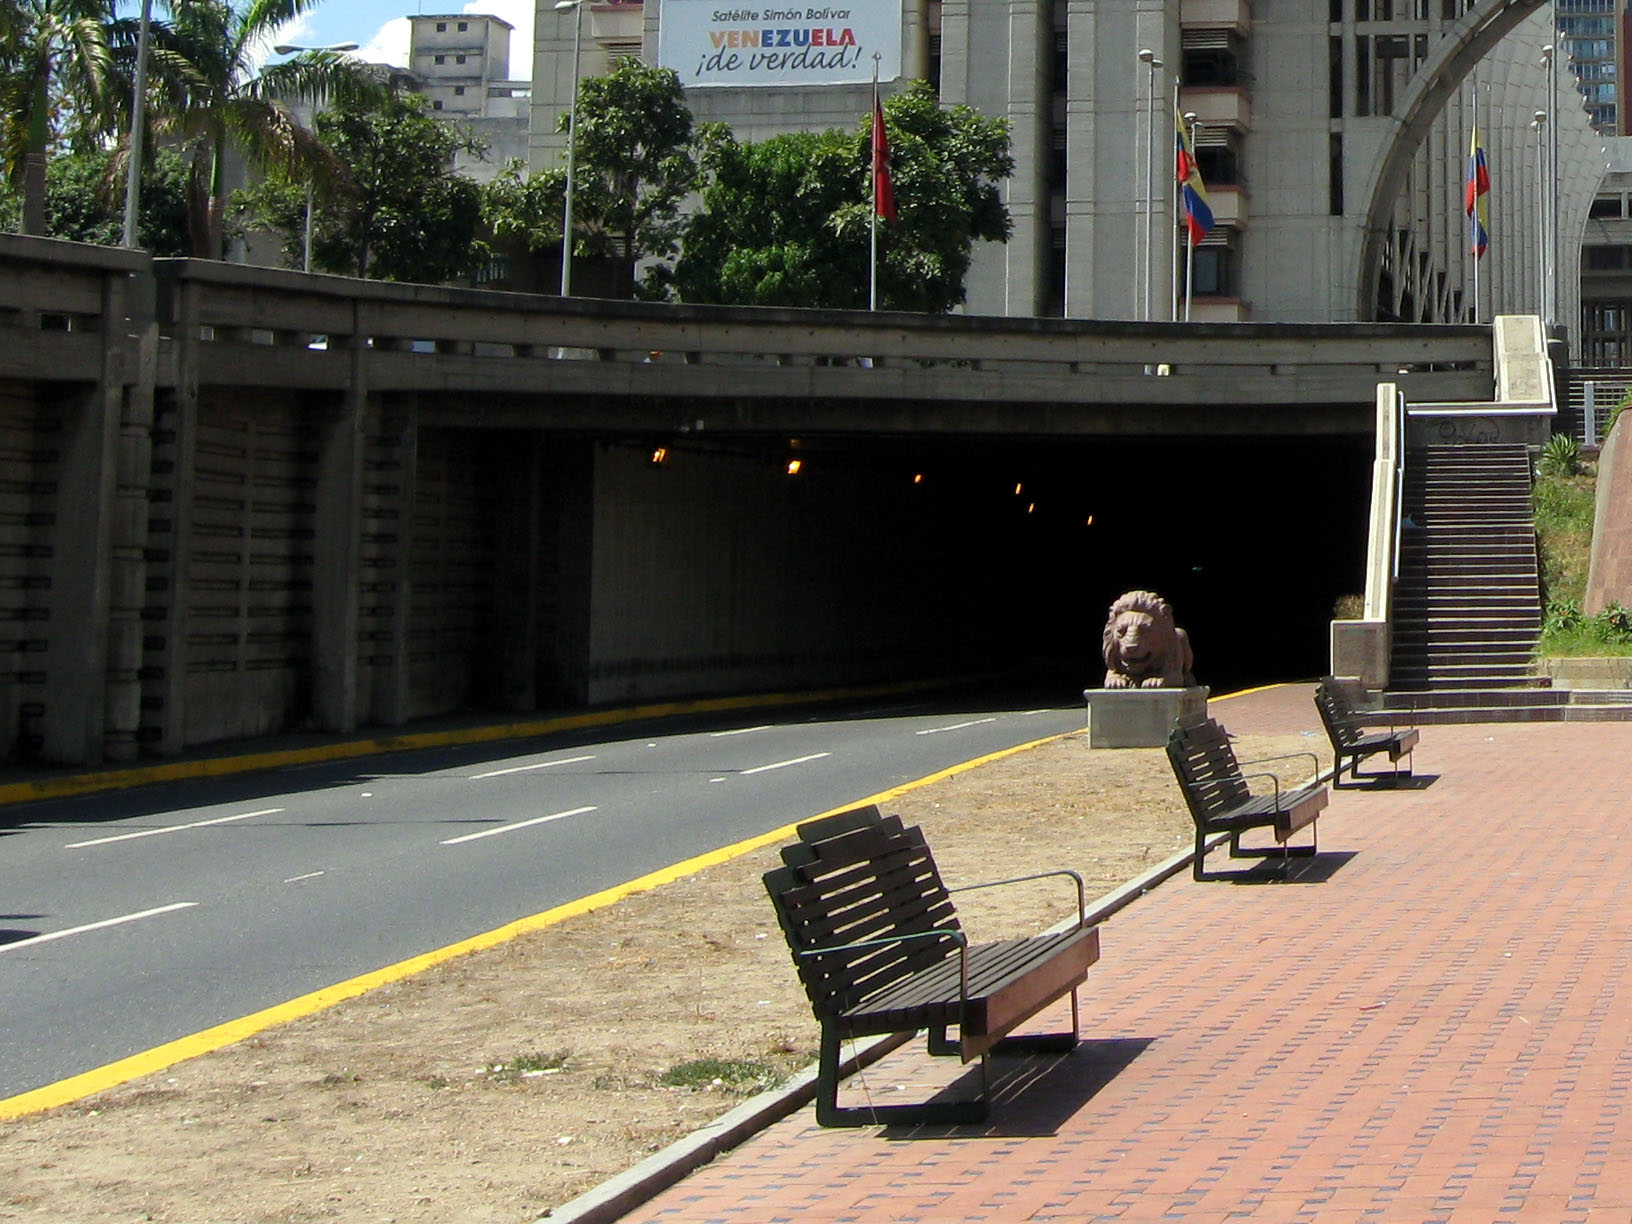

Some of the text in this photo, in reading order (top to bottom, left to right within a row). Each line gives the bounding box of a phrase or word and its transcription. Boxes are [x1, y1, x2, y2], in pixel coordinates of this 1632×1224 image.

[711, 7, 851, 22] Satélite Simón Bolívar
[709, 28, 856, 49] VENEZUELA
[749, 42, 862, 71] verdad!
